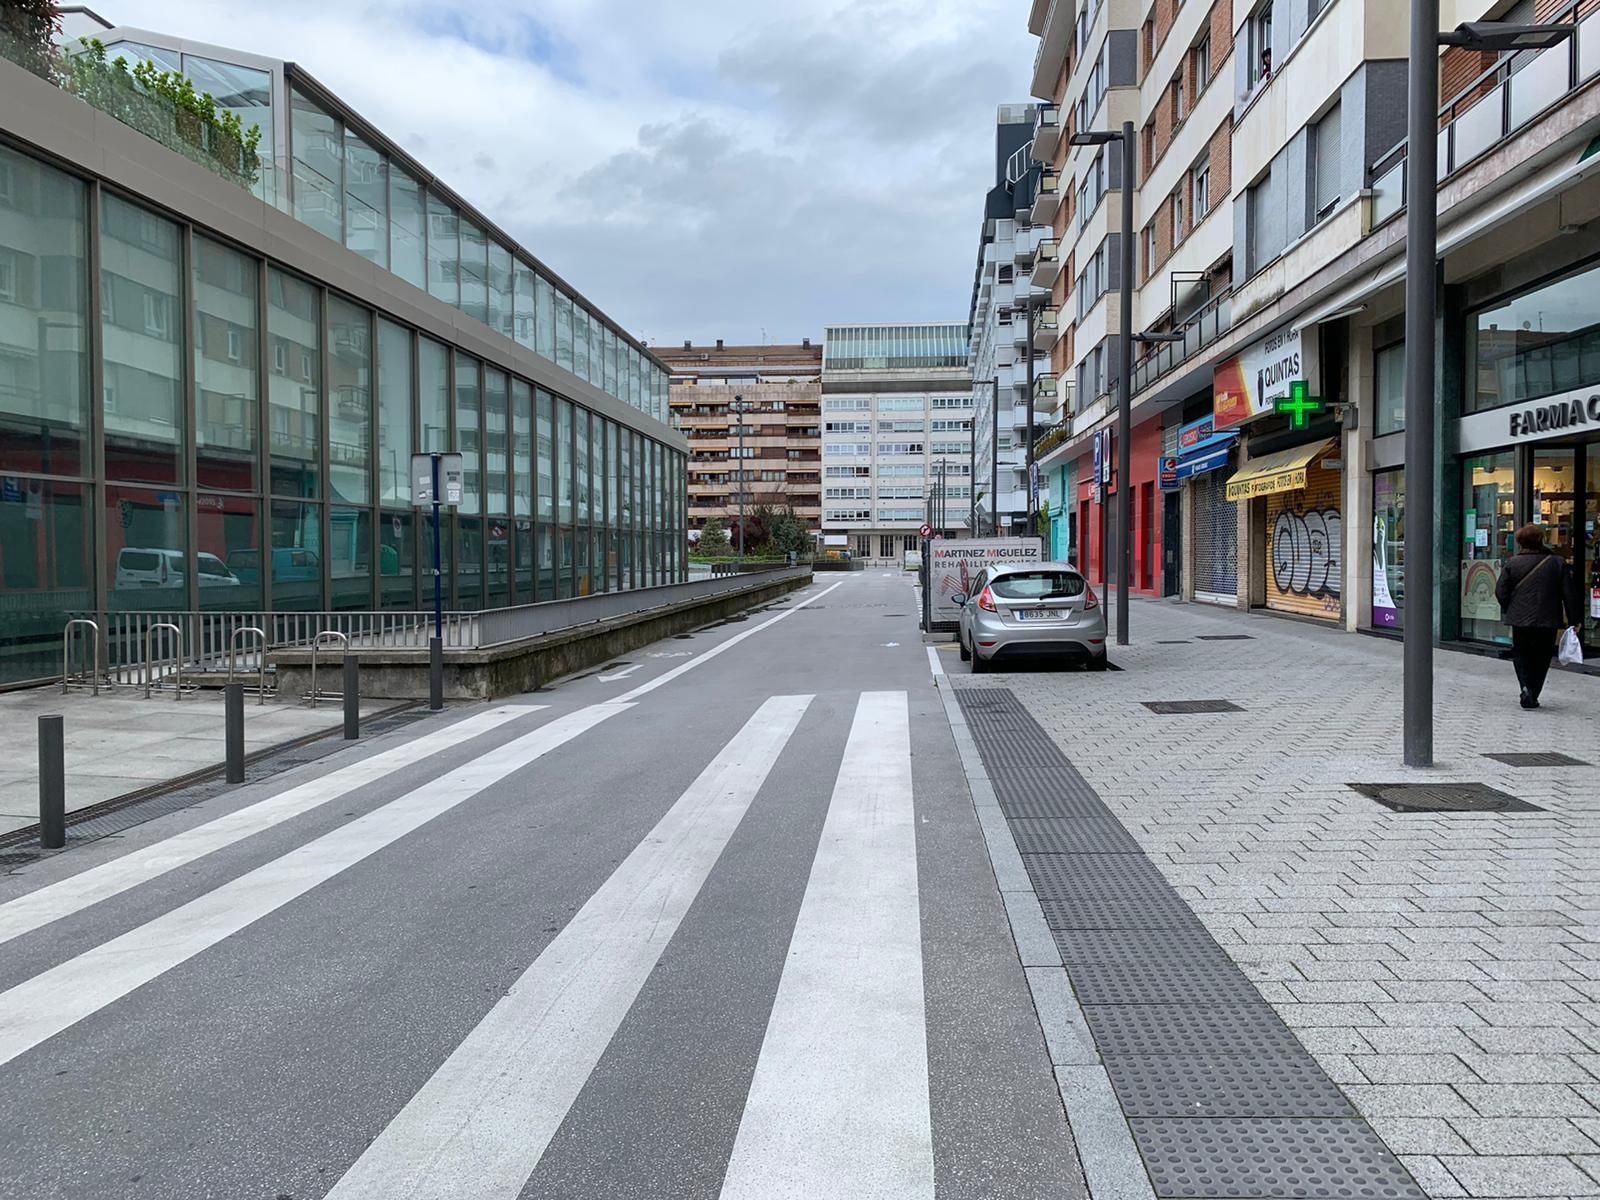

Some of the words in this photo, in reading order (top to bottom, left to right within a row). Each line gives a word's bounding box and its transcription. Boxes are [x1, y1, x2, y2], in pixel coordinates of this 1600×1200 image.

[1265, 352, 1300, 388] QUINTAS
[1231, 482, 1250, 496] QUINTAS
[934, 549, 985, 558] MARTINEZ
[987, 548, 1037, 557] MIGUELEZ
